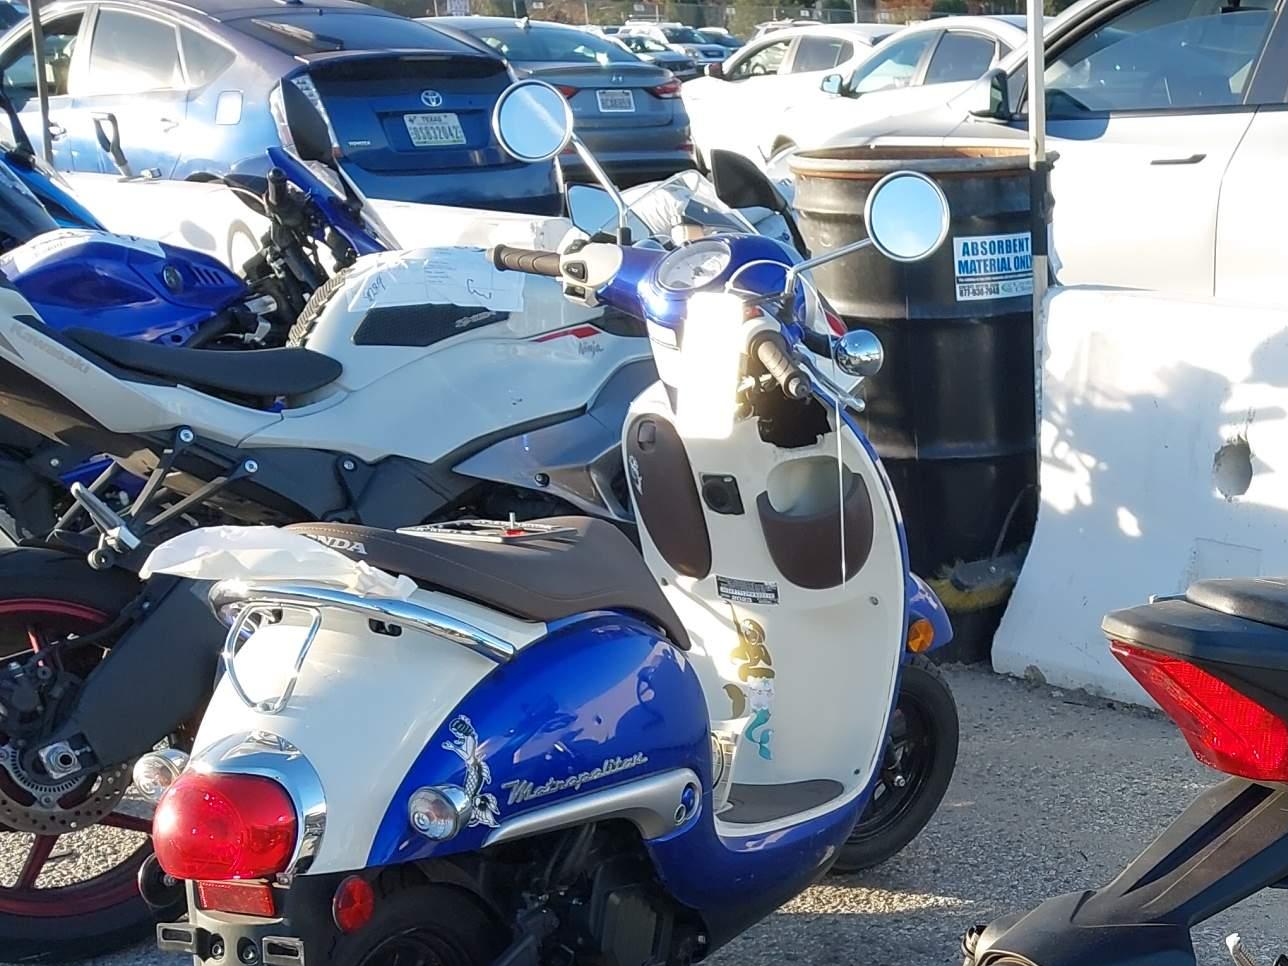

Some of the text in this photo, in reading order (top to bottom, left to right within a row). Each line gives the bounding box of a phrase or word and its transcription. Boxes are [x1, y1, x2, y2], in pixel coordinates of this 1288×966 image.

[962, 237, 1030, 257] ABSORBENT
[958, 257, 1012, 275] MATERIAL
[578, 340, 604, 358] Ninja
[306, 534, 369, 556] NDA
[501, 752, 649, 805] Metropolitan
